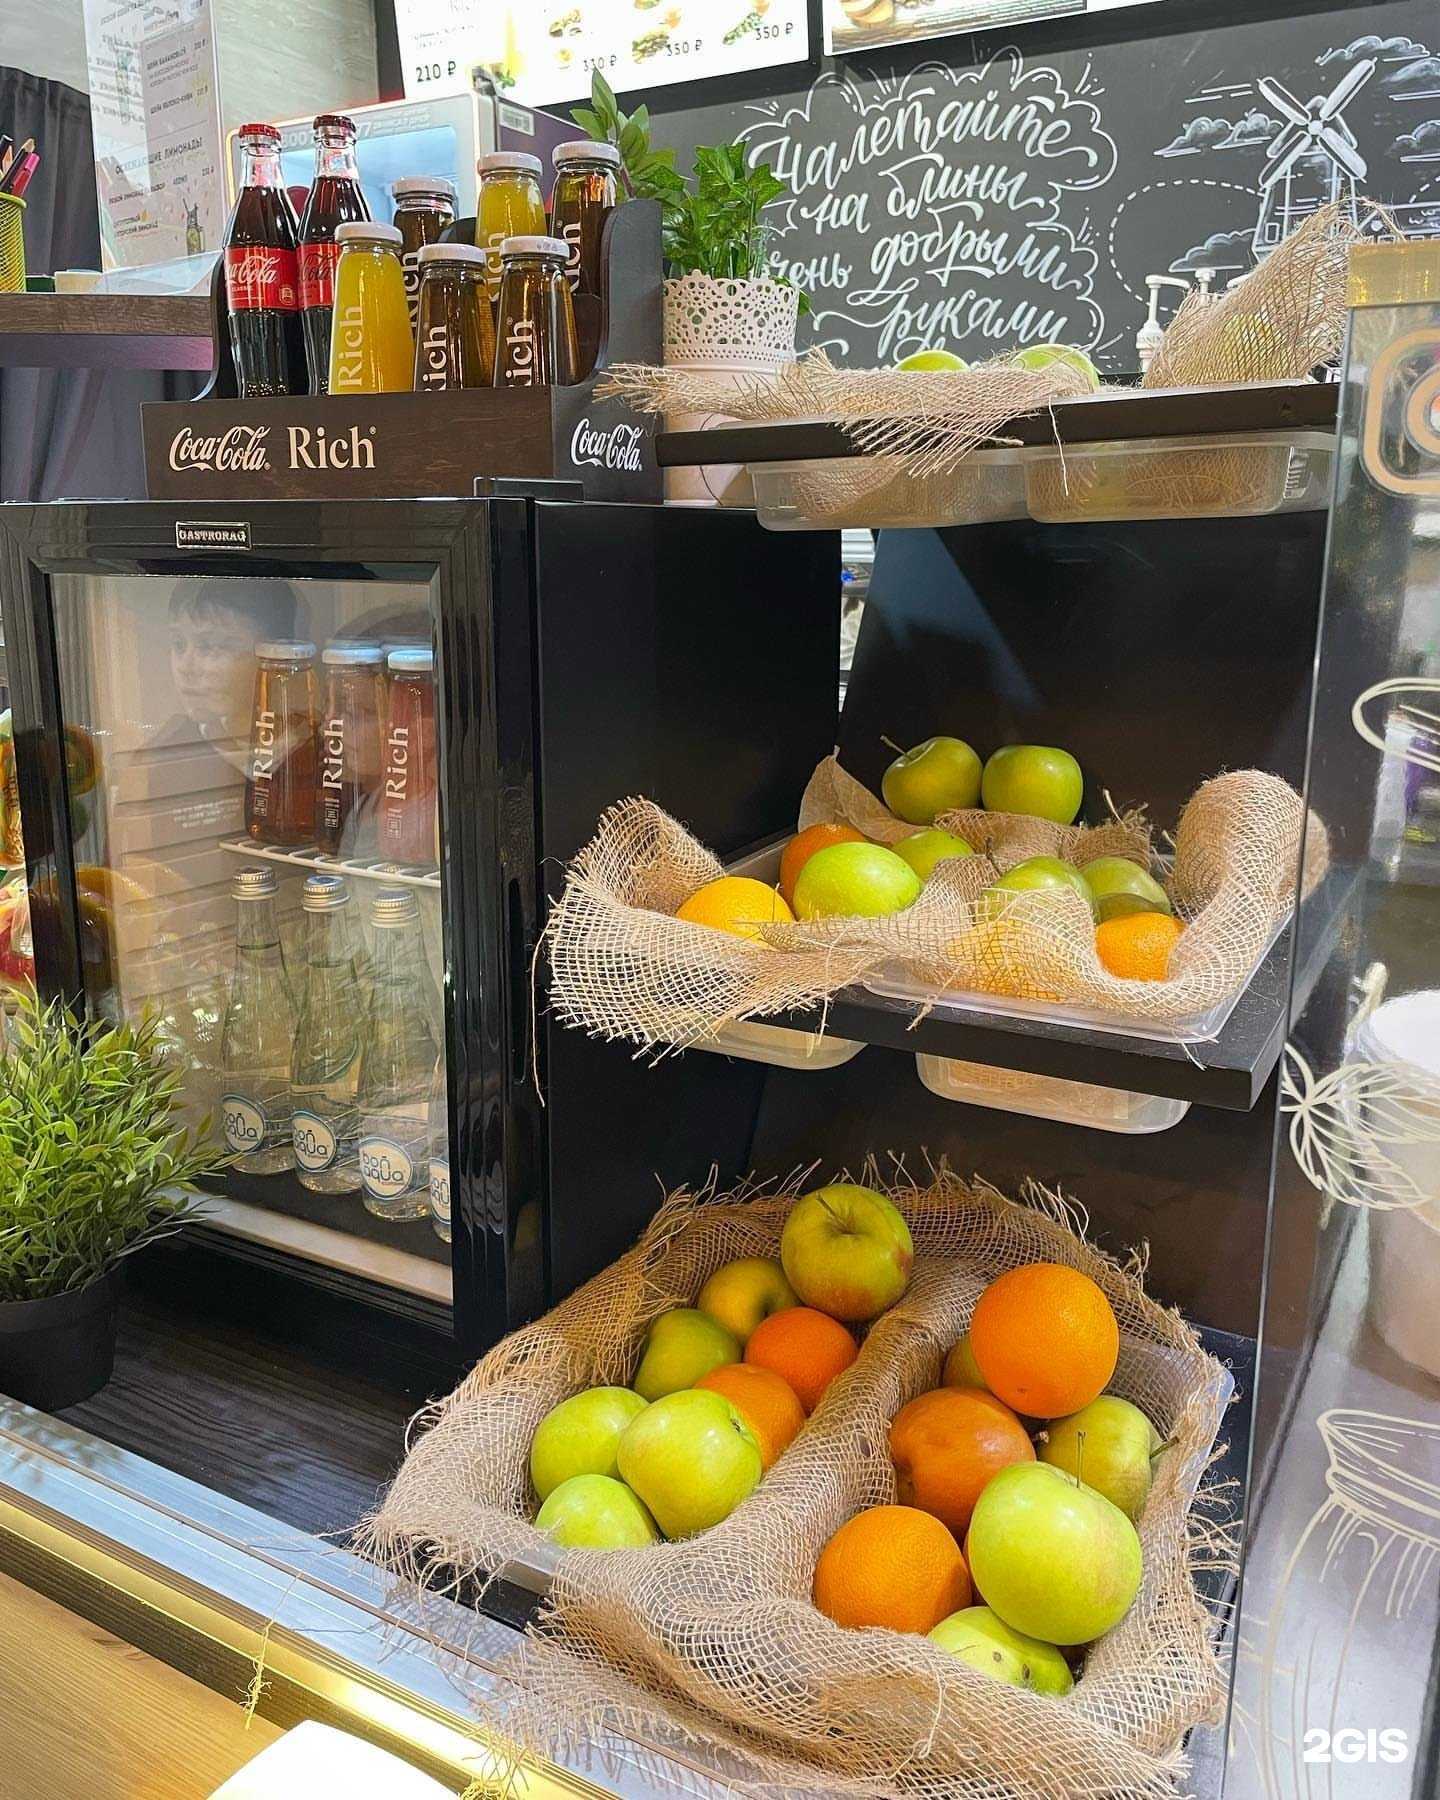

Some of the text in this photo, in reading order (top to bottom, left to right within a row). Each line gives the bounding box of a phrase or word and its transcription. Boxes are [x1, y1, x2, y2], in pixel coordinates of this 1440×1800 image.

[667, 42, 689, 56] 350
[755, 24, 779, 40] 350
[415, 63, 441, 82] 210
[748, 87, 1098, 195] Налетайте
[800, 152, 1045, 235] на блины
[770, 202, 1083, 304] чень добрыми
[337, 305, 363, 388] Rich
[423, 324, 447, 392] ich
[868, 288, 1068, 360] руками
[168, 425, 377, 472] Coca-Cola Rich
[571, 417, 643, 472] Coca-Cola
[178, 528, 247, 542] GASTRORAG
[253, 711, 275, 781] Rich
[322, 718, 344, 790] Rich
[385, 726, 409, 801] Rich
